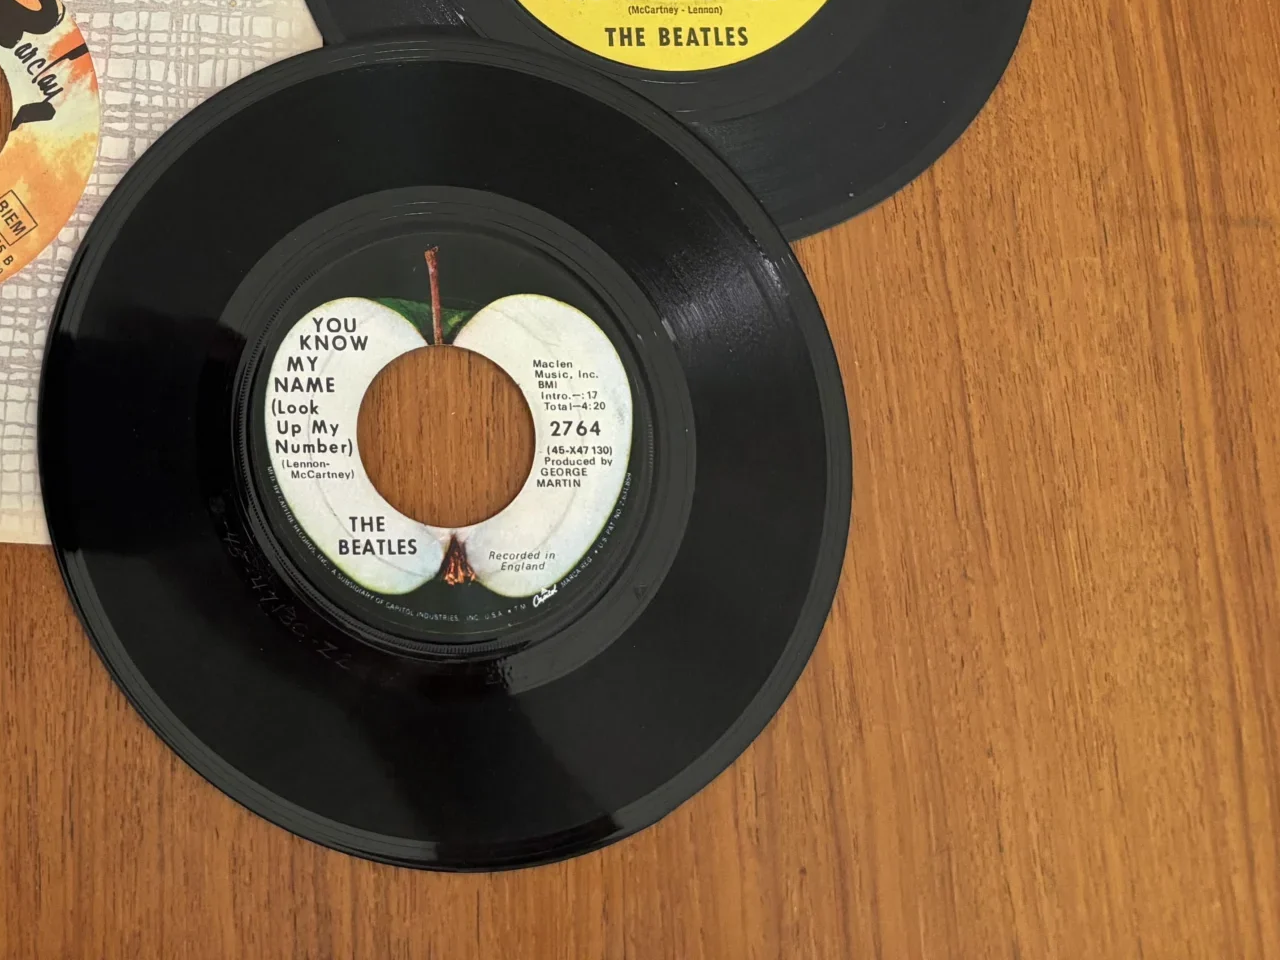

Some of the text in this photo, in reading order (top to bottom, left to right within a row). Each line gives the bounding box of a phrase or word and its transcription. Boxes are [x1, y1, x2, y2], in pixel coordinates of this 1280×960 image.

[628, 5, 723, 16] (McCartney Lennon)
[605, 26, 748, 47] THE BEATLES
[312, 318, 357, 333] YOU
[300, 335, 368, 351] KNOW
[287, 357, 318, 371] MY
[533, 360, 573, 369] Maclen
[534, 370, 598, 380] Music, Inc.
[274, 377, 335, 393] NAME
[538, 381, 558, 389] BMI
[271, 399, 319, 416] (Look
[276, 420, 339, 438] Up My
[550, 420, 601, 437] 2764
[275, 439, 353, 457] Number)
[281, 459, 330, 470] (Lennon-
[544, 457, 613, 467] Produced by
[291, 470, 355, 480] McCartney)
[541, 468, 588, 477] GEORGE
[537, 479, 581, 488] MARTIN
[349, 517, 385, 532] THE
[338, 539, 417, 556] BEATLES
[488, 551, 555, 560] Recorded in
[500, 562, 545, 572] England
[337, 572, 375, 599] SUBSIDIARY
[386, 602, 413, 616] CAPITOL
[560, 570, 581, 587] MARCA
